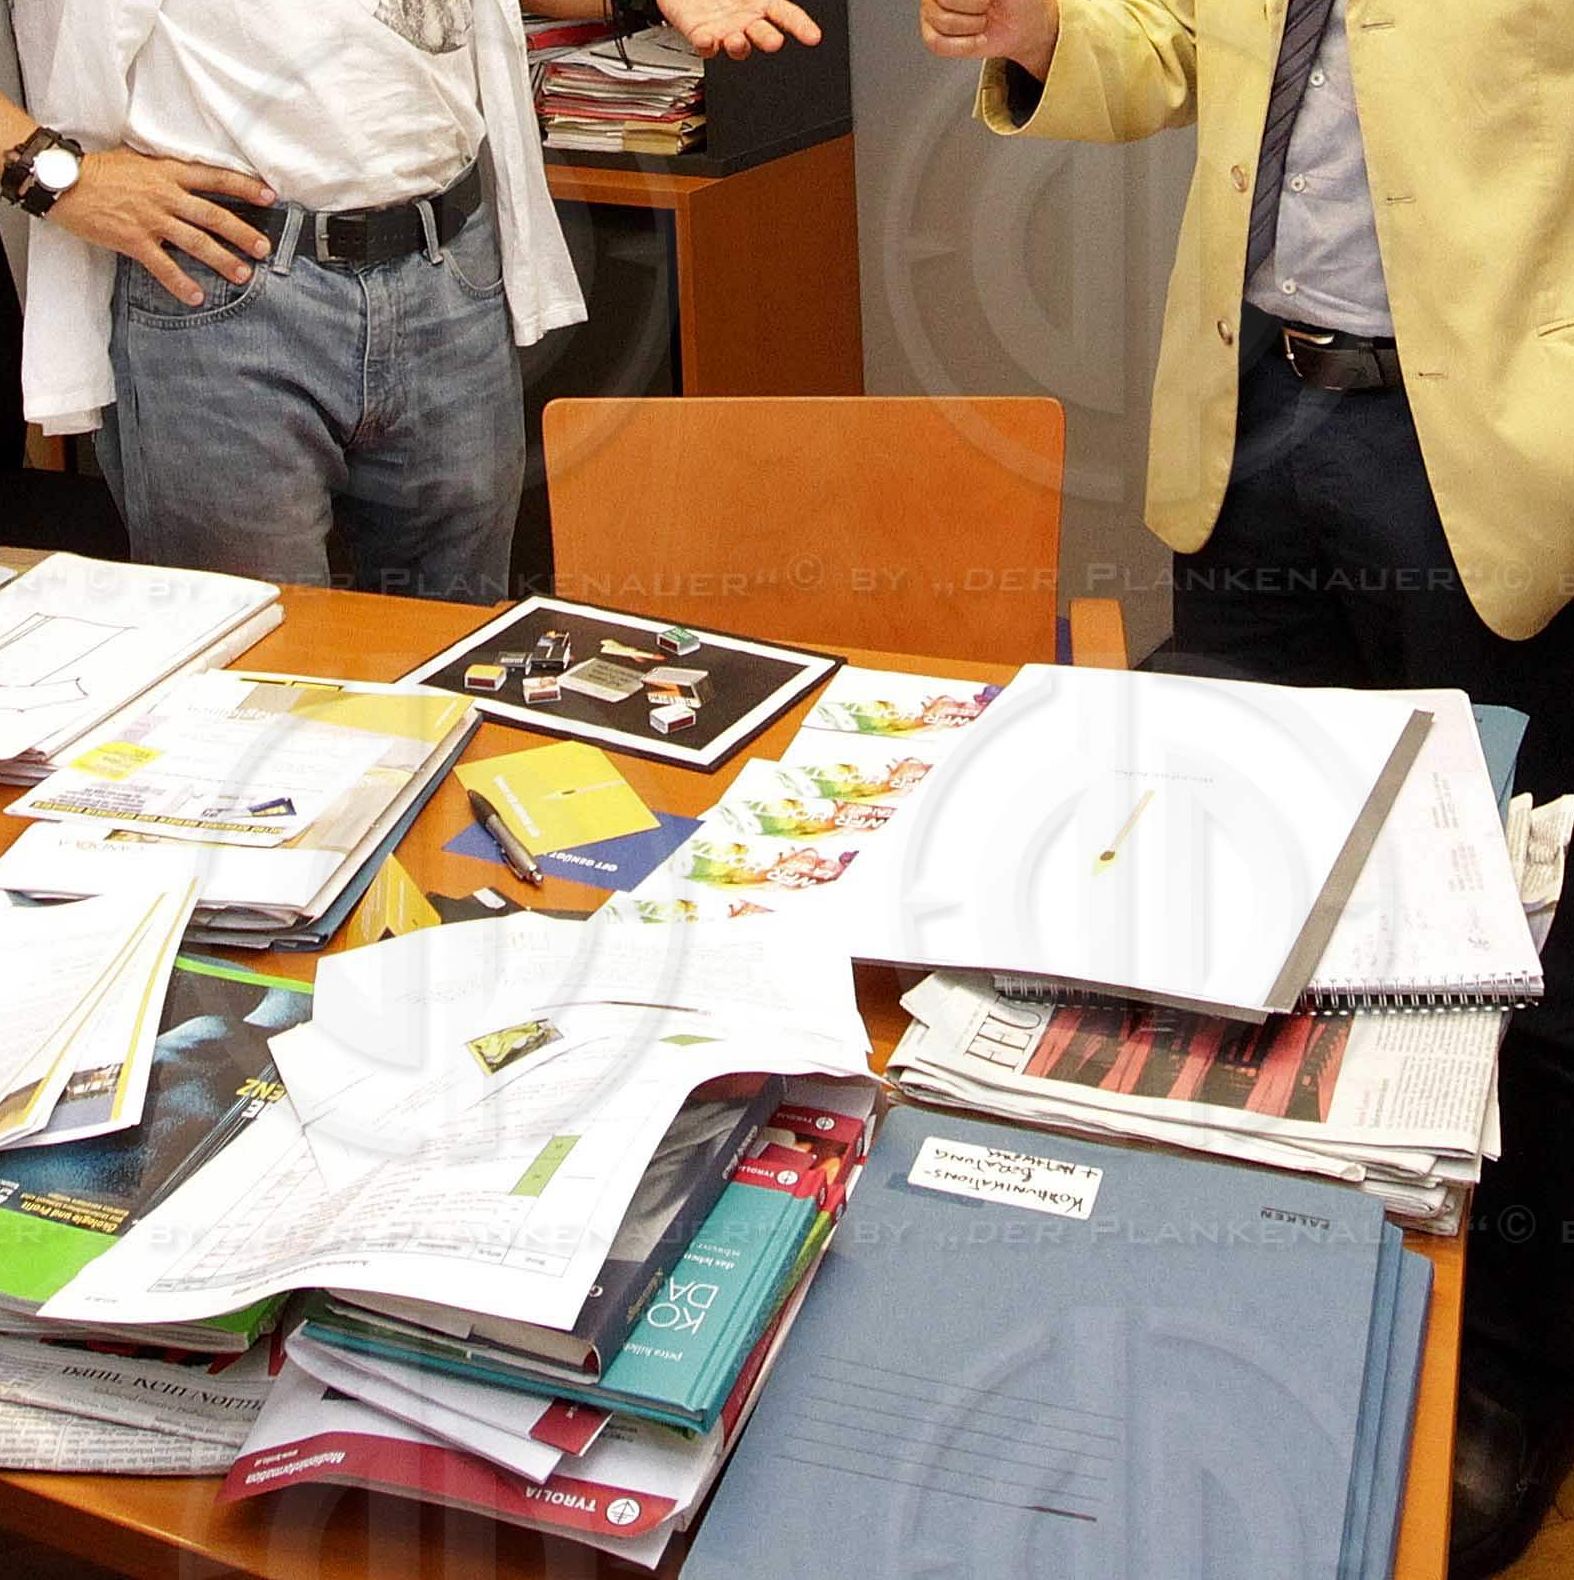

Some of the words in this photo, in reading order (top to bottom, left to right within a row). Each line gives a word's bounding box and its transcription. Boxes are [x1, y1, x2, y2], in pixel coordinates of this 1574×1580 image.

[1262, 1207, 1331, 1231] FALKEN
[670, 1277, 718, 1309] DA
[647, 1302, 705, 1335] KO
[245, 1451, 346, 1486] Medieninformation
[525, 1486, 597, 1512] TYROLIA
